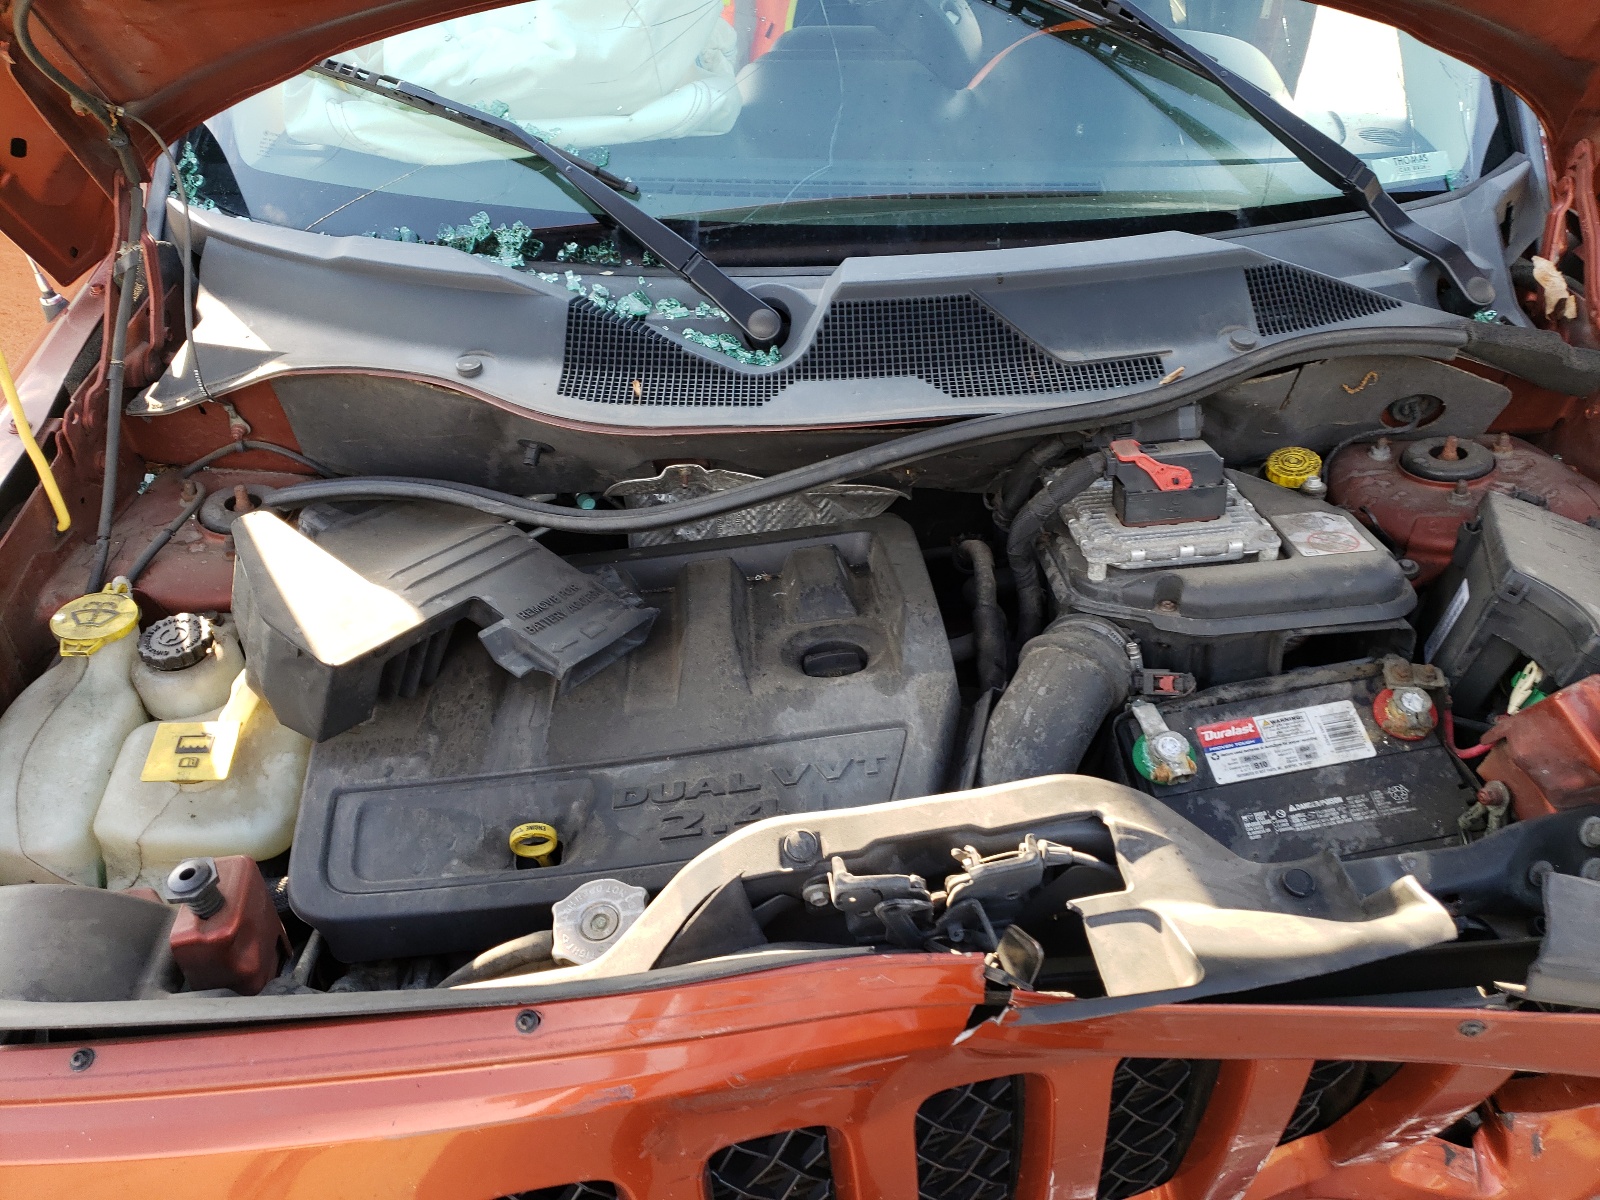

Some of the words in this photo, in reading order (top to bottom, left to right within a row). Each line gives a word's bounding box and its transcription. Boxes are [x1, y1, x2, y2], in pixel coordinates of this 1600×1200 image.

[1393, 154, 1429, 166] THOMAS
[516, 594, 562, 620] REMOVE
[523, 610, 568, 636] BATTERY
[1201, 722, 1255, 741] Duralast
[612, 771, 762, 810] DUAL
[771, 756, 887, 787] VVT
[526, 824, 547, 832] ENGINE
